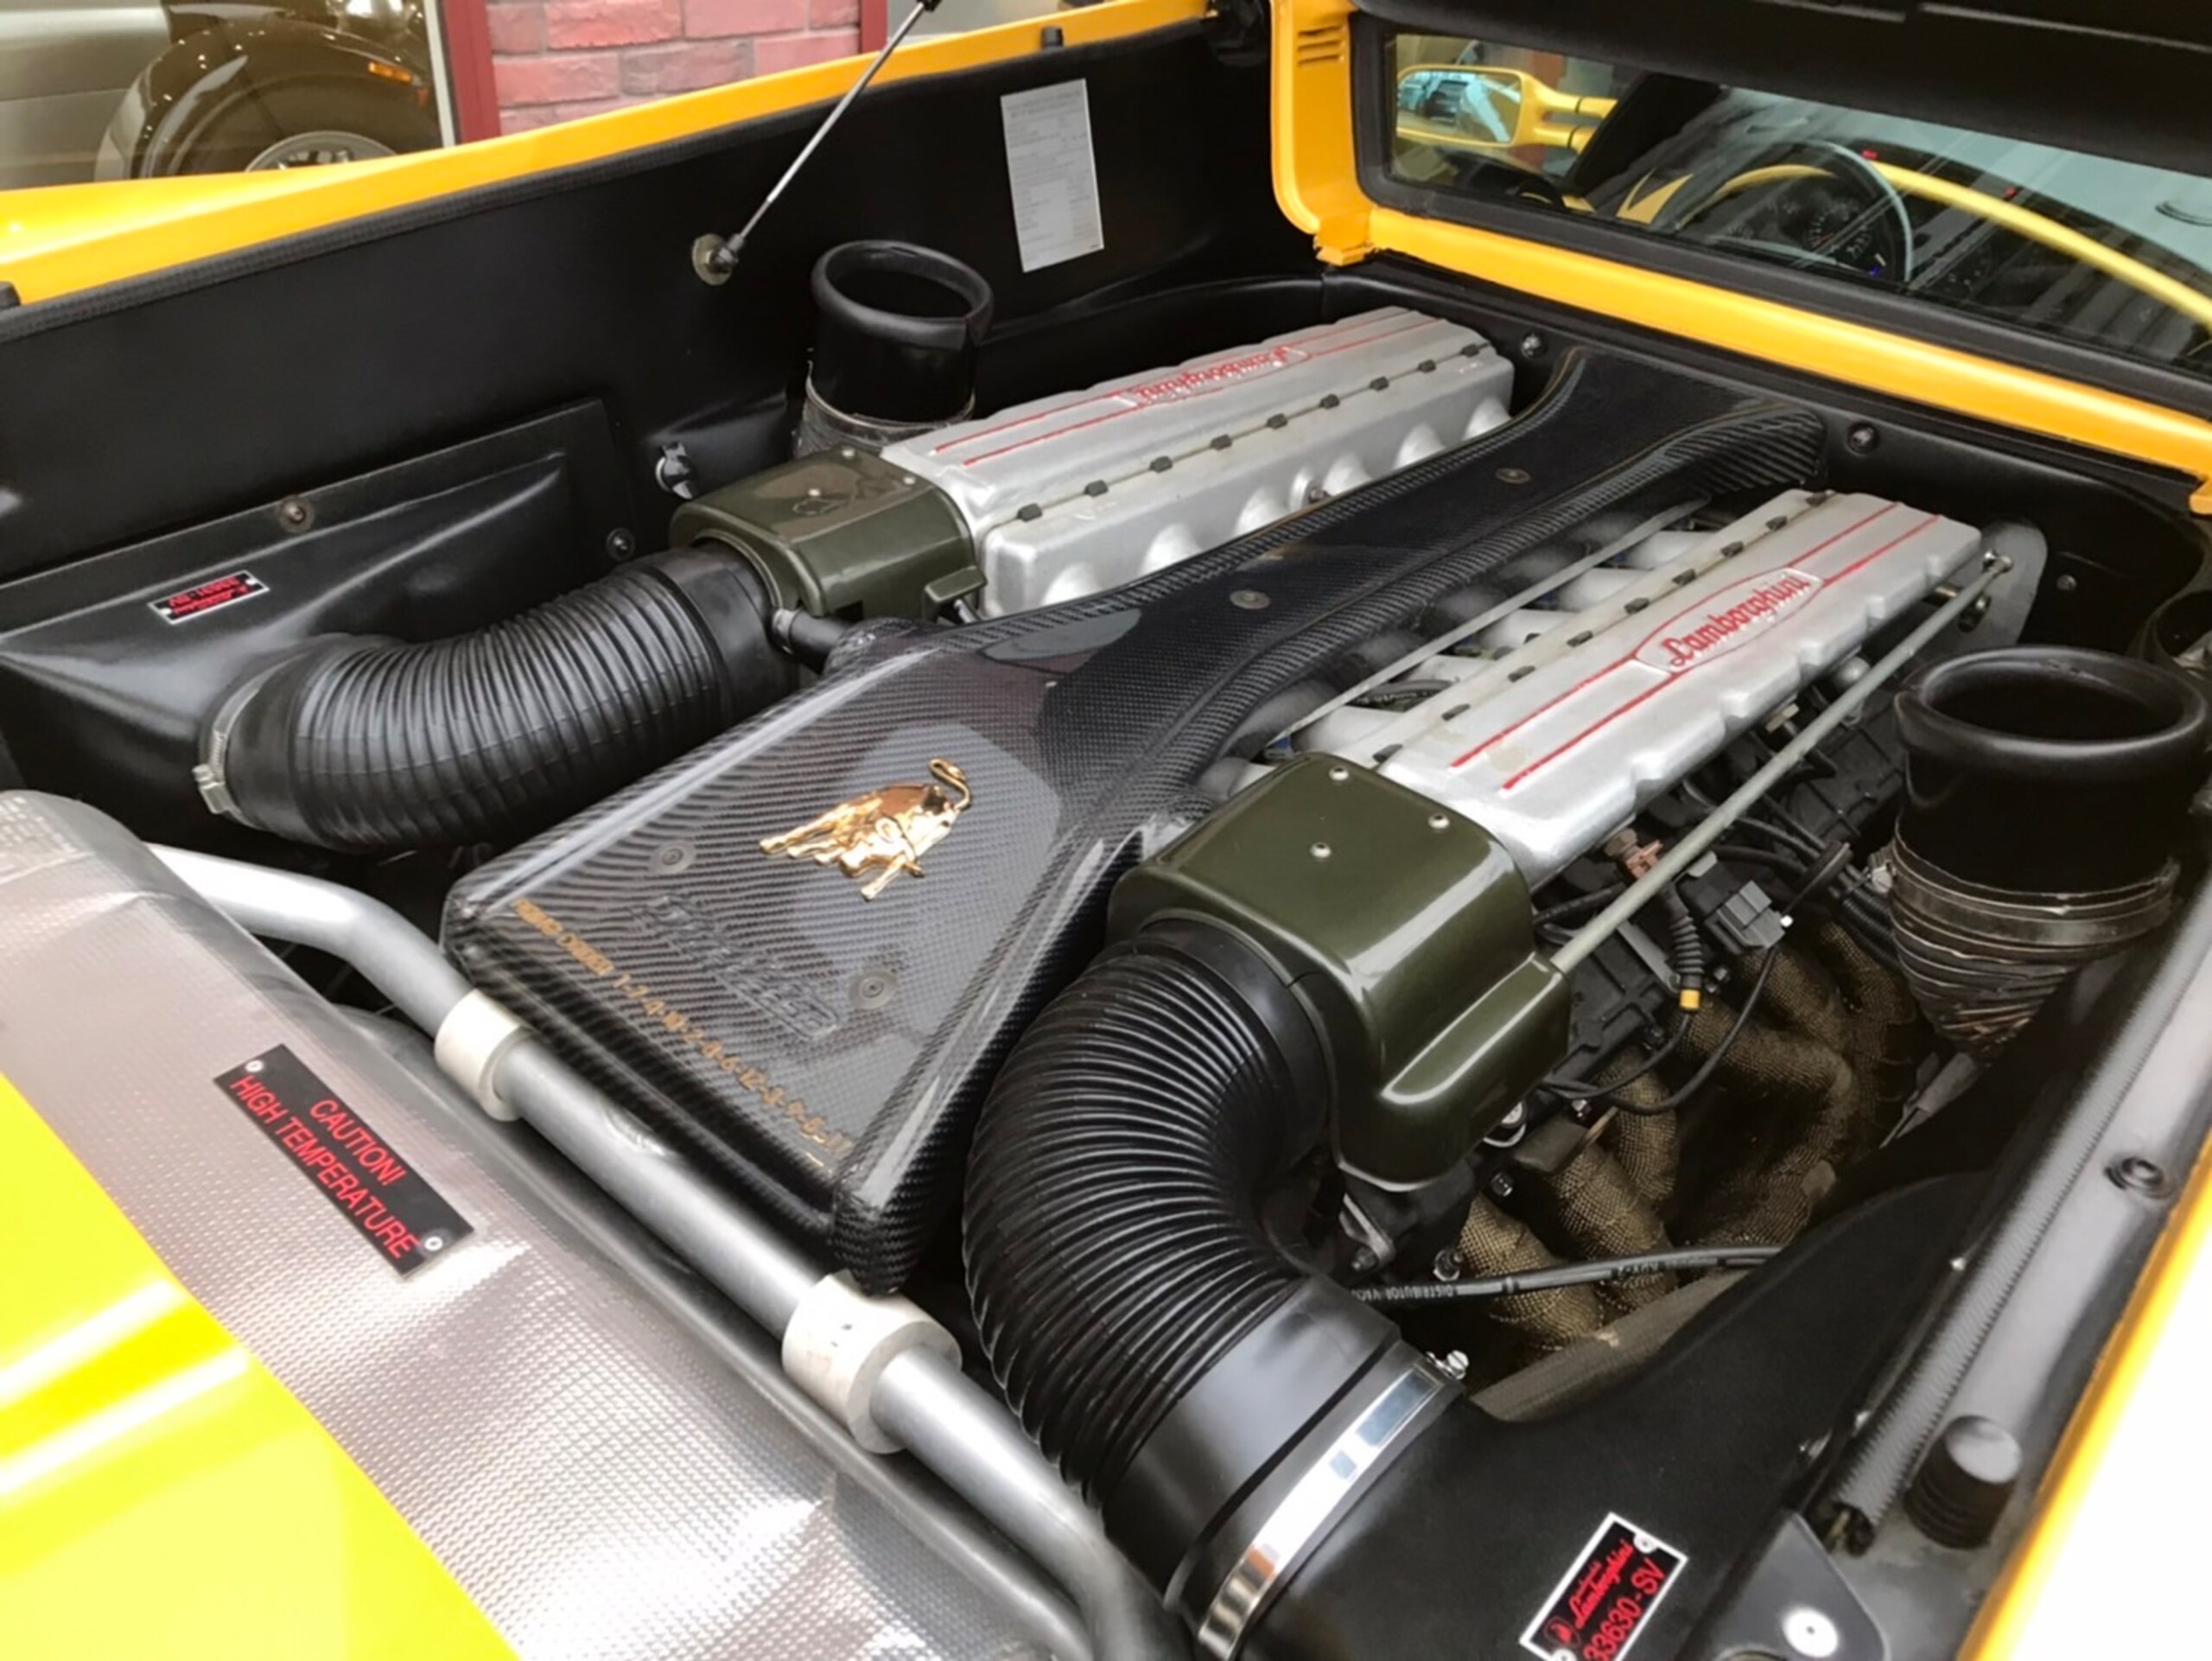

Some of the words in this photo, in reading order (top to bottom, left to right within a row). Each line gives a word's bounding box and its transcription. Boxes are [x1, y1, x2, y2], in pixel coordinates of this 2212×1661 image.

[1662, 575, 1812, 667] Lamborghini
[230, 1075, 288, 1123] HIGH
[276, 1117, 422, 1259] TEMPERATURE
[309, 1099, 406, 1186] CAUTION!
[1568, 1537, 1635, 1629] Lamborghini
